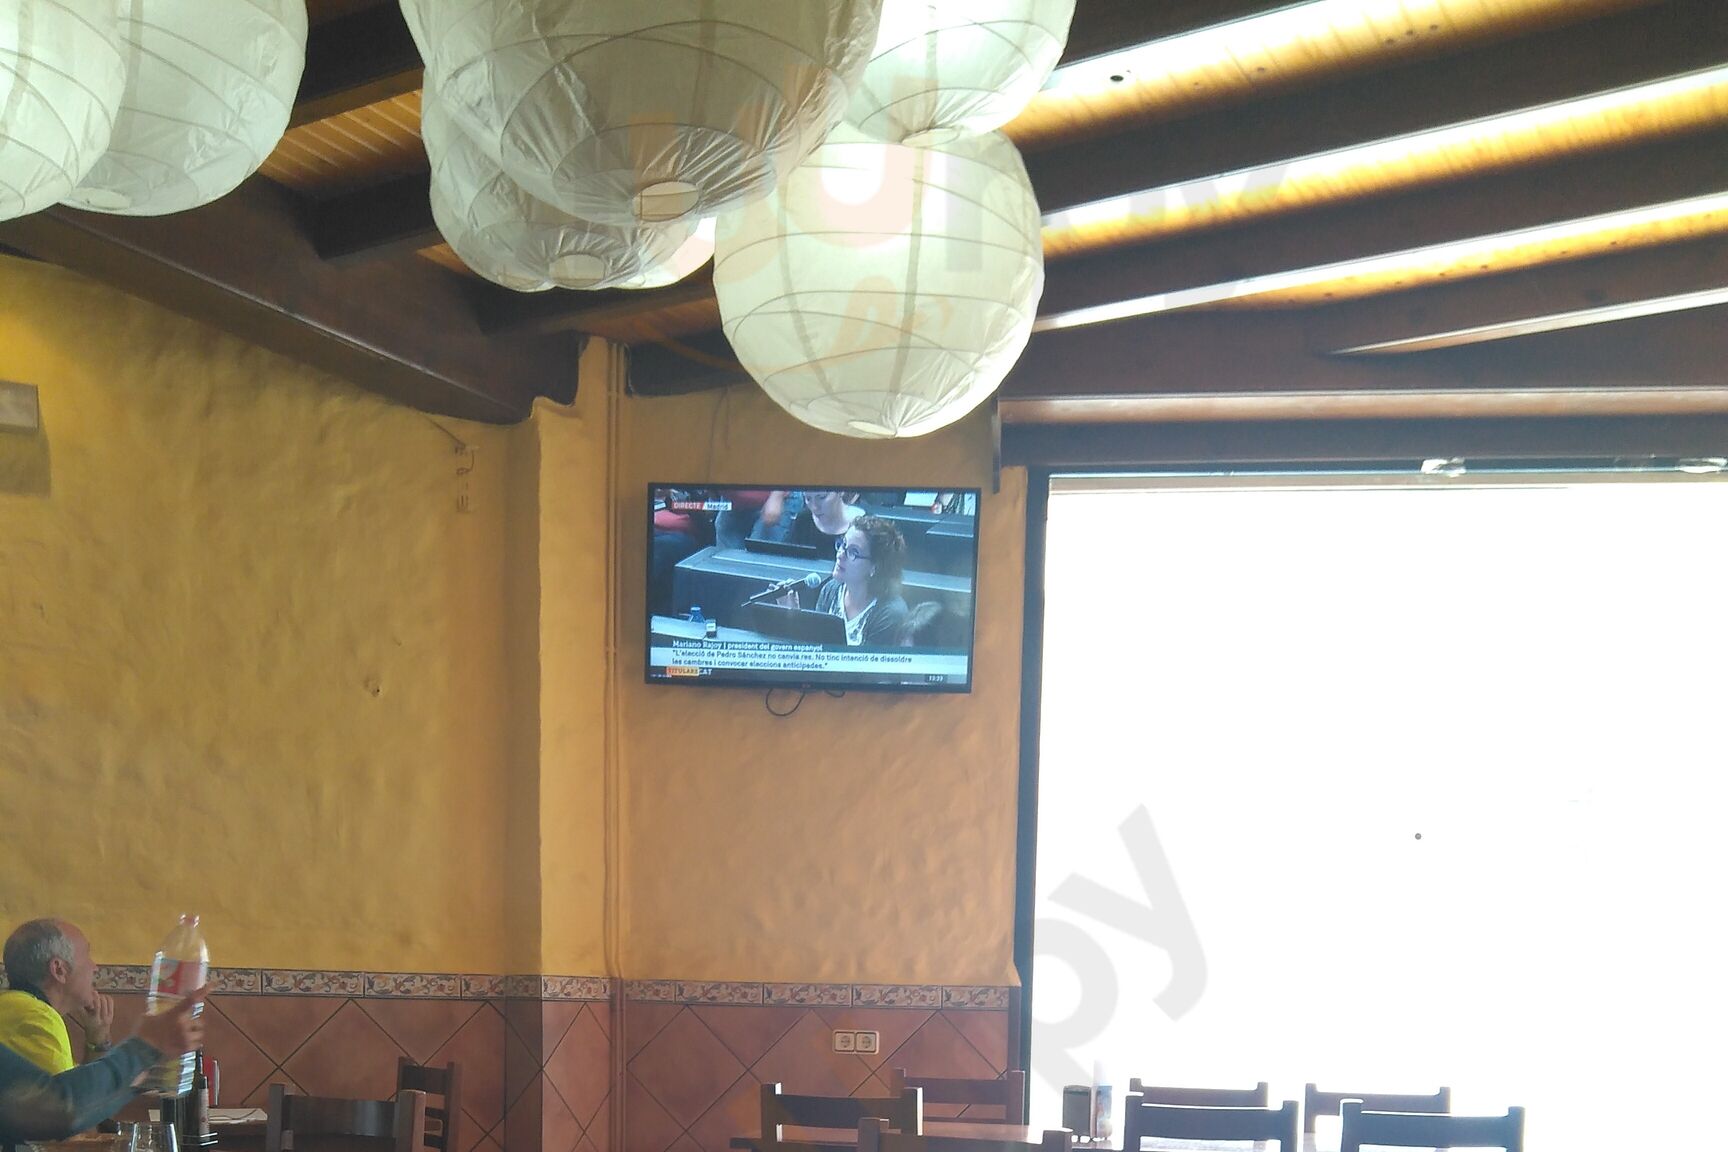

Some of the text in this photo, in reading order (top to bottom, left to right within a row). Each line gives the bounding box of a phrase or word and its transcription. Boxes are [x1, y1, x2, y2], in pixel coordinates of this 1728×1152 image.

[672, 640, 702, 648] Mariano
[702, 640, 721, 649] Rajoy
[727, 642, 758, 650] president
[759, 642, 770, 650] del
[771, 643, 792, 651] govern
[793, 644, 823, 652] espanyol
[672, 657, 682, 665] les
[717, 659, 748, 667] convocar
[749, 659, 781, 668] eleccions
[716, 650, 736, 658] Pedro
[777, 652, 800, 660] canvia
[880, 655, 912, 663] dissoldre
